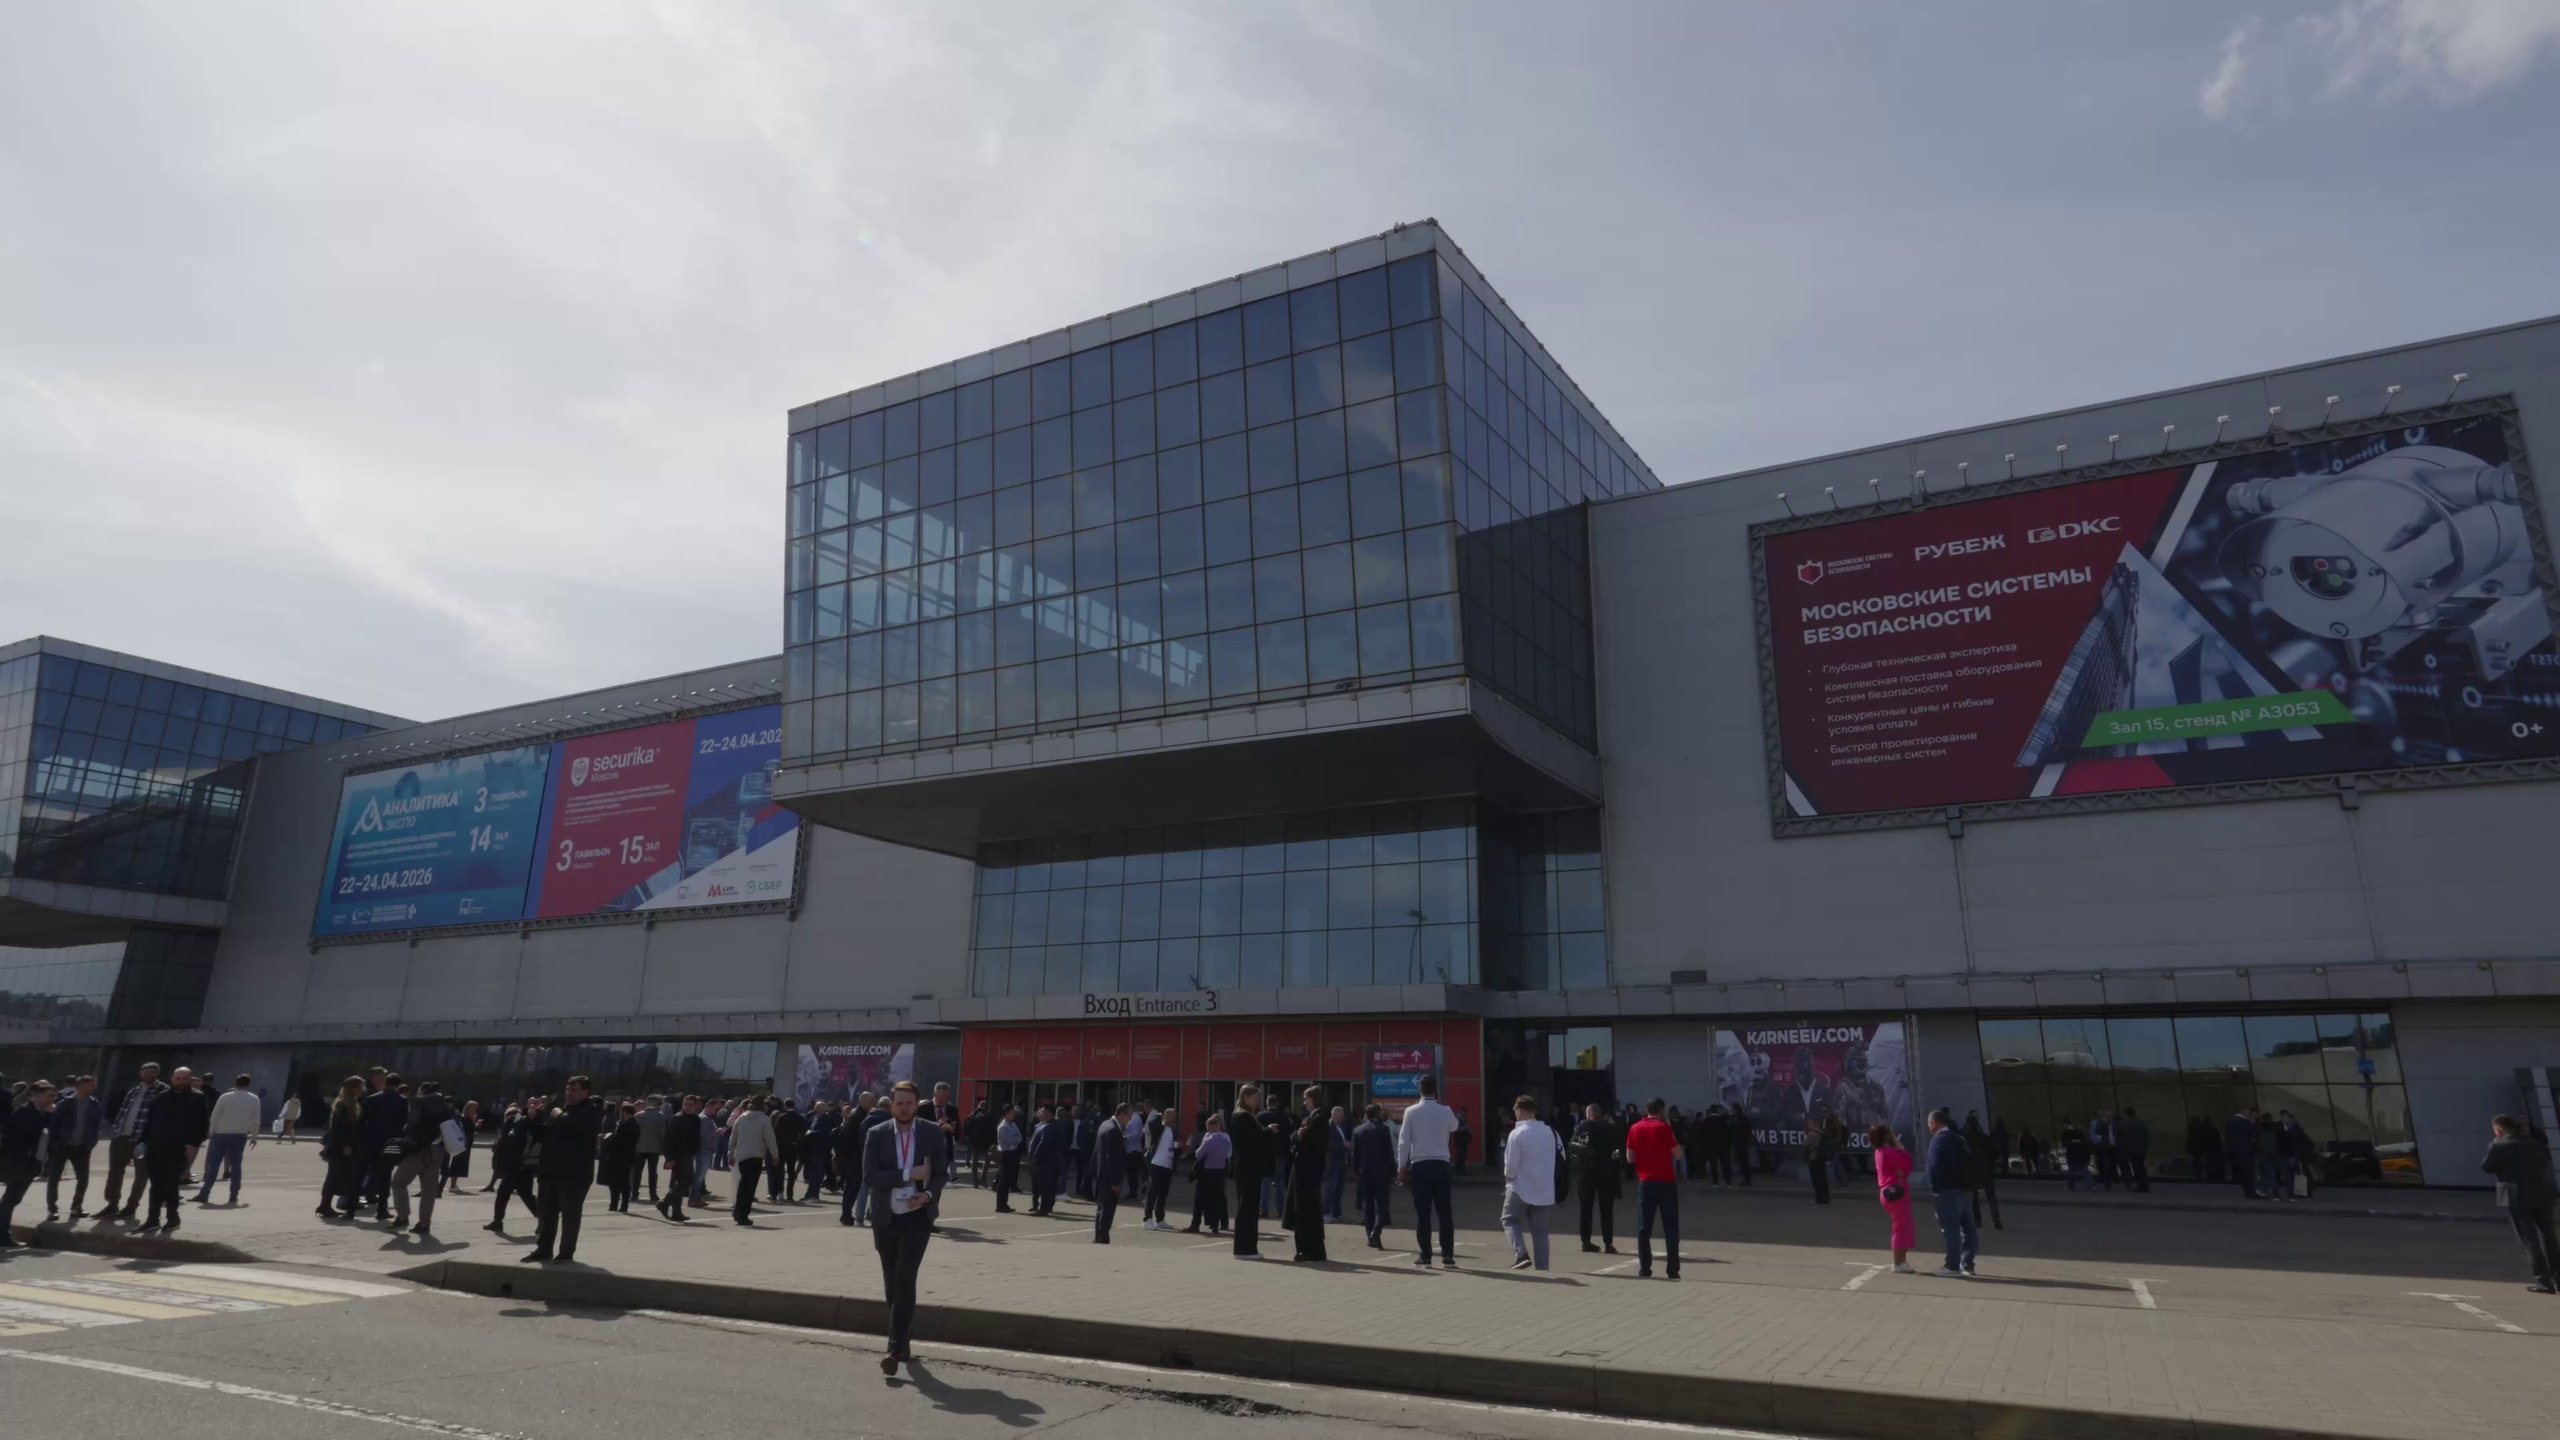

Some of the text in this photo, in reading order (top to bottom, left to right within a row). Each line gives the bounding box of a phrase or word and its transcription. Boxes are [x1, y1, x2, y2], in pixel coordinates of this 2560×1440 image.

[2058, 516, 2122, 539] DKC
[1827, 551, 1894, 568] МОСКОВСКИЕ СИСТЕМЫ
[1914, 533, 2007, 561] РУБЕЖ
[1828, 563, 1871, 575] БЕЗОПАСНОСТИ
[1801, 566, 2092, 622] МОСКОВСКИЕ СИСТЕМЫ
[1803, 605, 1992, 645] БЕЗОПАСНОСТИ
[1822, 642, 2018, 675] Глубокая техническая экспертиза
[1824, 659, 2043, 692] Комплексная поставка оборудования
[1825, 683, 1948, 705] систем безопасности
[1827, 697, 1994, 723] Конкурентные цены и гибкие
[2110, 721, 2141, 735] Зал
[2145, 717, 2170, 731] 15,
[2174, 713, 2227, 729] стенд
[2231, 708, 2252, 723] №
[700, 728, 782, 754] 22-24.04.202
[1828, 719, 1918, 737] условия оплаты
[2511, 722, 2544, 738] 0+
[1830, 732, 1978, 754] Быстрое проектирование
[593, 746, 654, 772] securika
[1831, 748, 1947, 767] инженерных систем
[591, 772, 619, 782] Moscow
[382, 791, 459, 817] АНАЛИТИКА
[474, 786, 528, 813] 3 ПАВИЛЬОН
[385, 816, 416, 831] ЭКСПО
[470, 824, 492, 852] 14
[494, 831, 509, 841] ЗАЛ
[619, 835, 660, 865] 15 ЗАЛ
[556, 839, 611, 872] 3 ПАВИЛЬОН
[339, 867, 433, 894] 22-24.04.2026
[758, 880, 782, 891] СБЕР
[1085, 990, 1217, 1018] Вход Entrance 3
[1747, 1026, 1864, 1046] KARNEEV.COM
[819, 1045, 891, 1056] KARNEEV.COM
